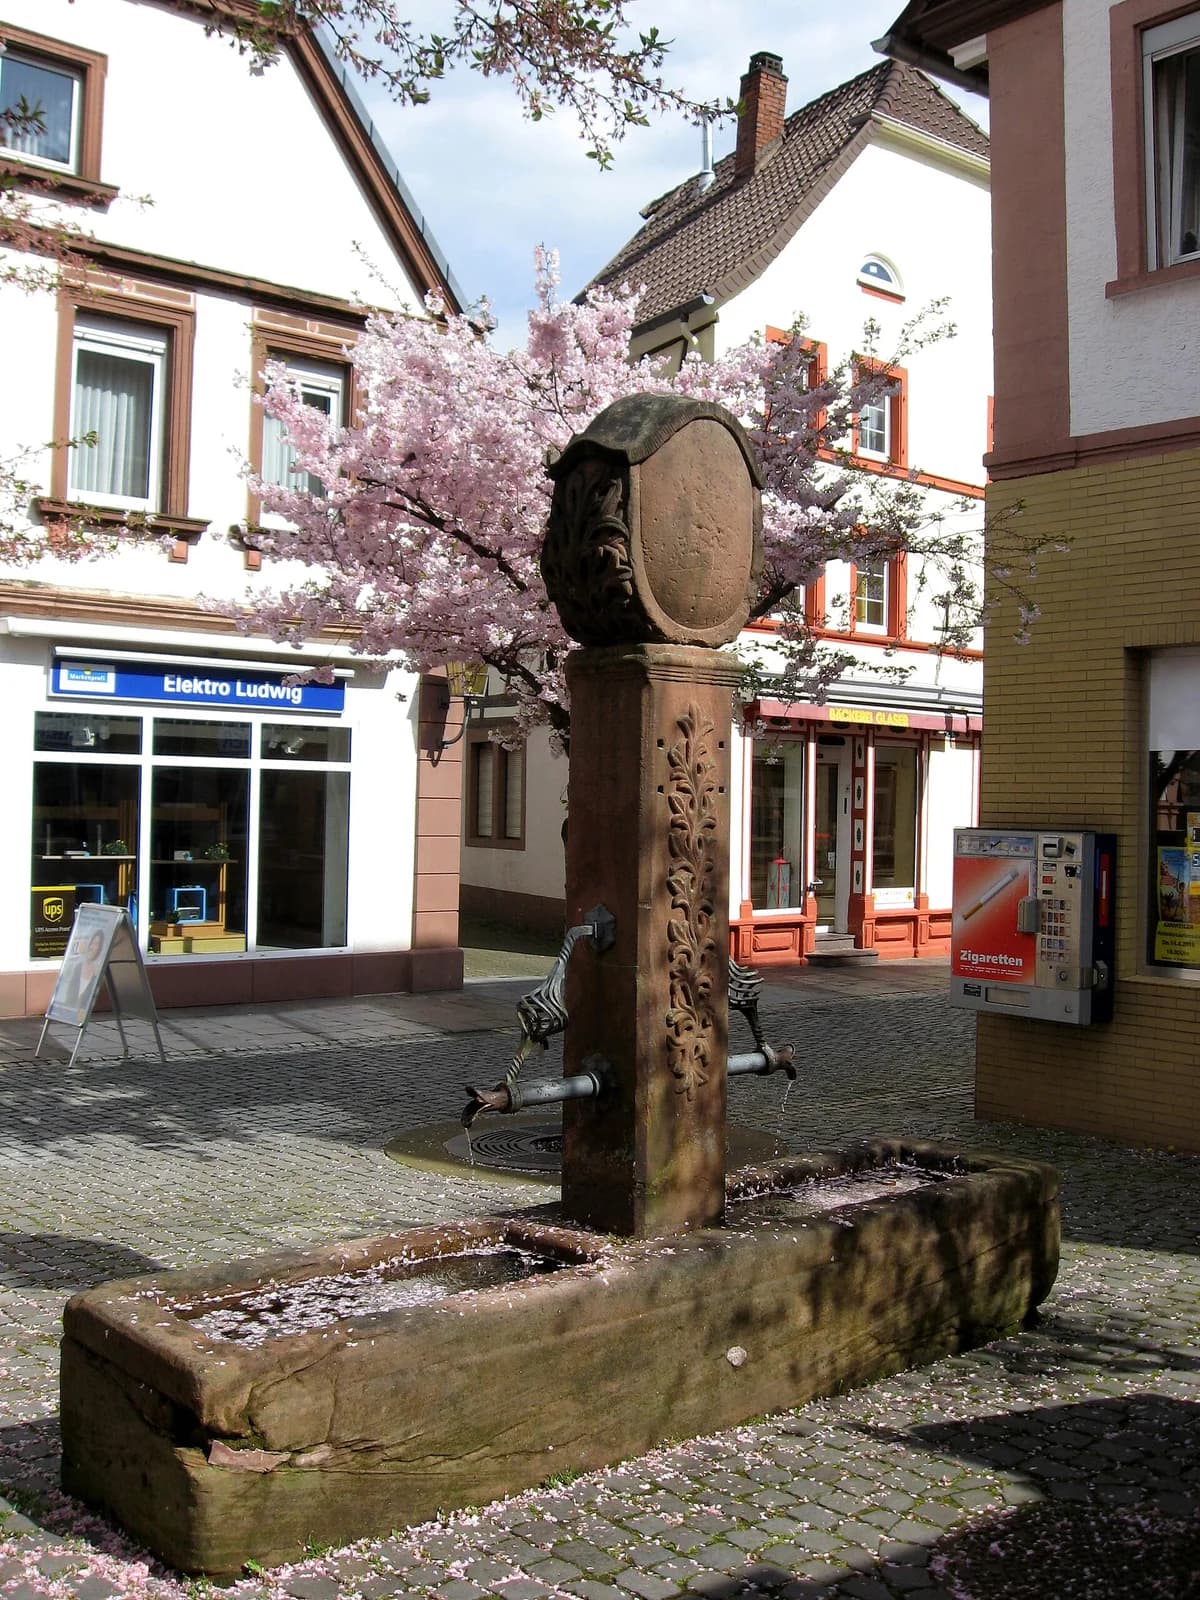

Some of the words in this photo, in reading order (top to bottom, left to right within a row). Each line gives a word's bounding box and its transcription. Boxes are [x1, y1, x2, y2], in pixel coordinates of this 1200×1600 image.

[163, 674, 230, 697] Elektro
[235, 680, 303, 704] Ludwig
[45, 905, 62, 919] ups
[960, 949, 1023, 966] Zigaretten
